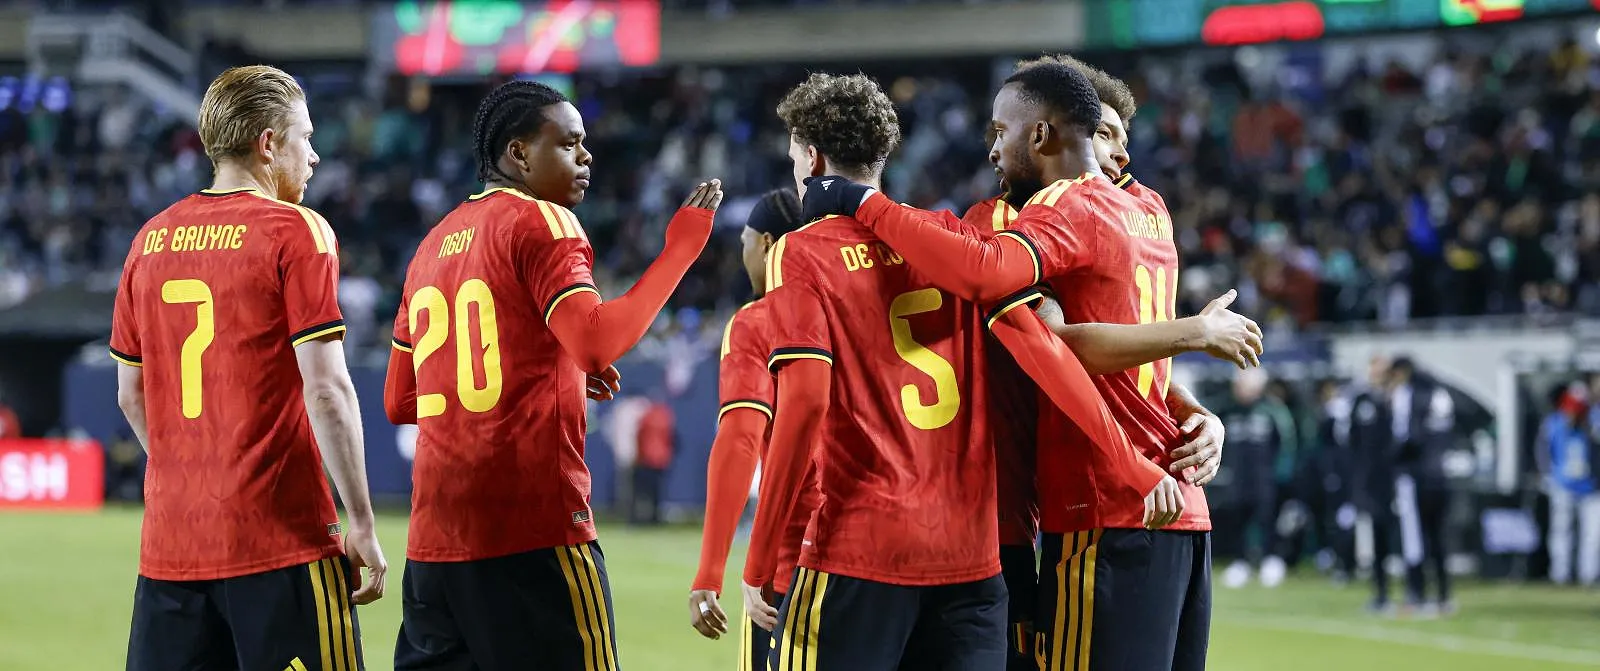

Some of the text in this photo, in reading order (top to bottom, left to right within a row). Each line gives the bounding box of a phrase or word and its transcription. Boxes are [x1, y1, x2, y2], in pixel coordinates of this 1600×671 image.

[143, 225, 247, 255] DE BRUYNE
[438, 226, 475, 258] NGOY
[840, 244, 874, 271] DE
[161, 279, 215, 419] 7
[409, 278, 503, 418] 20
[890, 288, 960, 429] 5
[0, 451, 68, 501] SH
